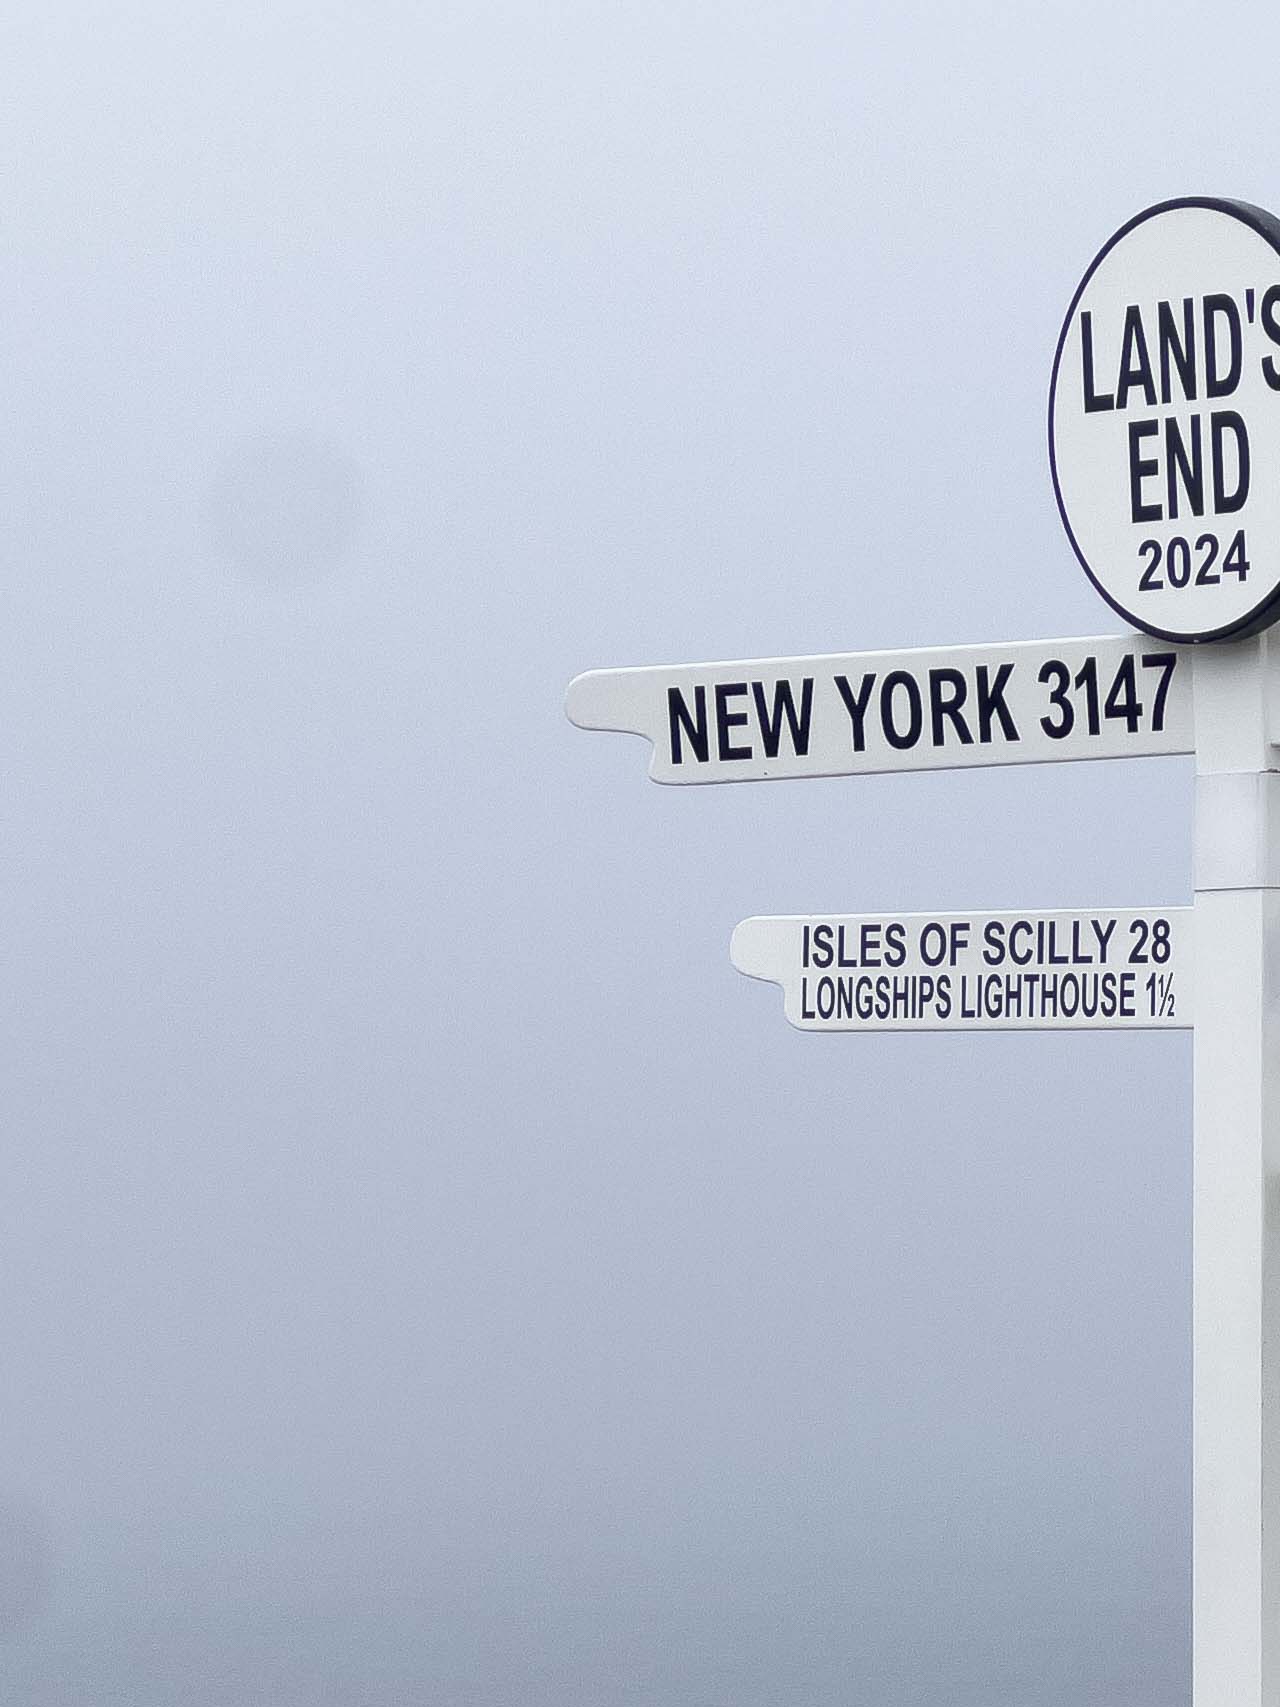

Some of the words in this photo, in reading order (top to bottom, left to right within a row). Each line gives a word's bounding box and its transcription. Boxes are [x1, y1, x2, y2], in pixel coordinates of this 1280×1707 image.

[1128, 410, 1250, 524] END
[1138, 529, 1251, 592] 2024
[667, 677, 814, 765] NEW
[834, 663, 1017, 753] YORK
[1038, 652, 1178, 740] 3147
[802, 923, 907, 969] ISLES
[919, 922, 971, 967] OF
[982, 919, 1117, 966] SCILLY
[1128, 918, 1171, 964] 28
[801, 974, 952, 1020] LONGSHIPS
[960, 972, 1136, 1019] LIGHTHOUSE
